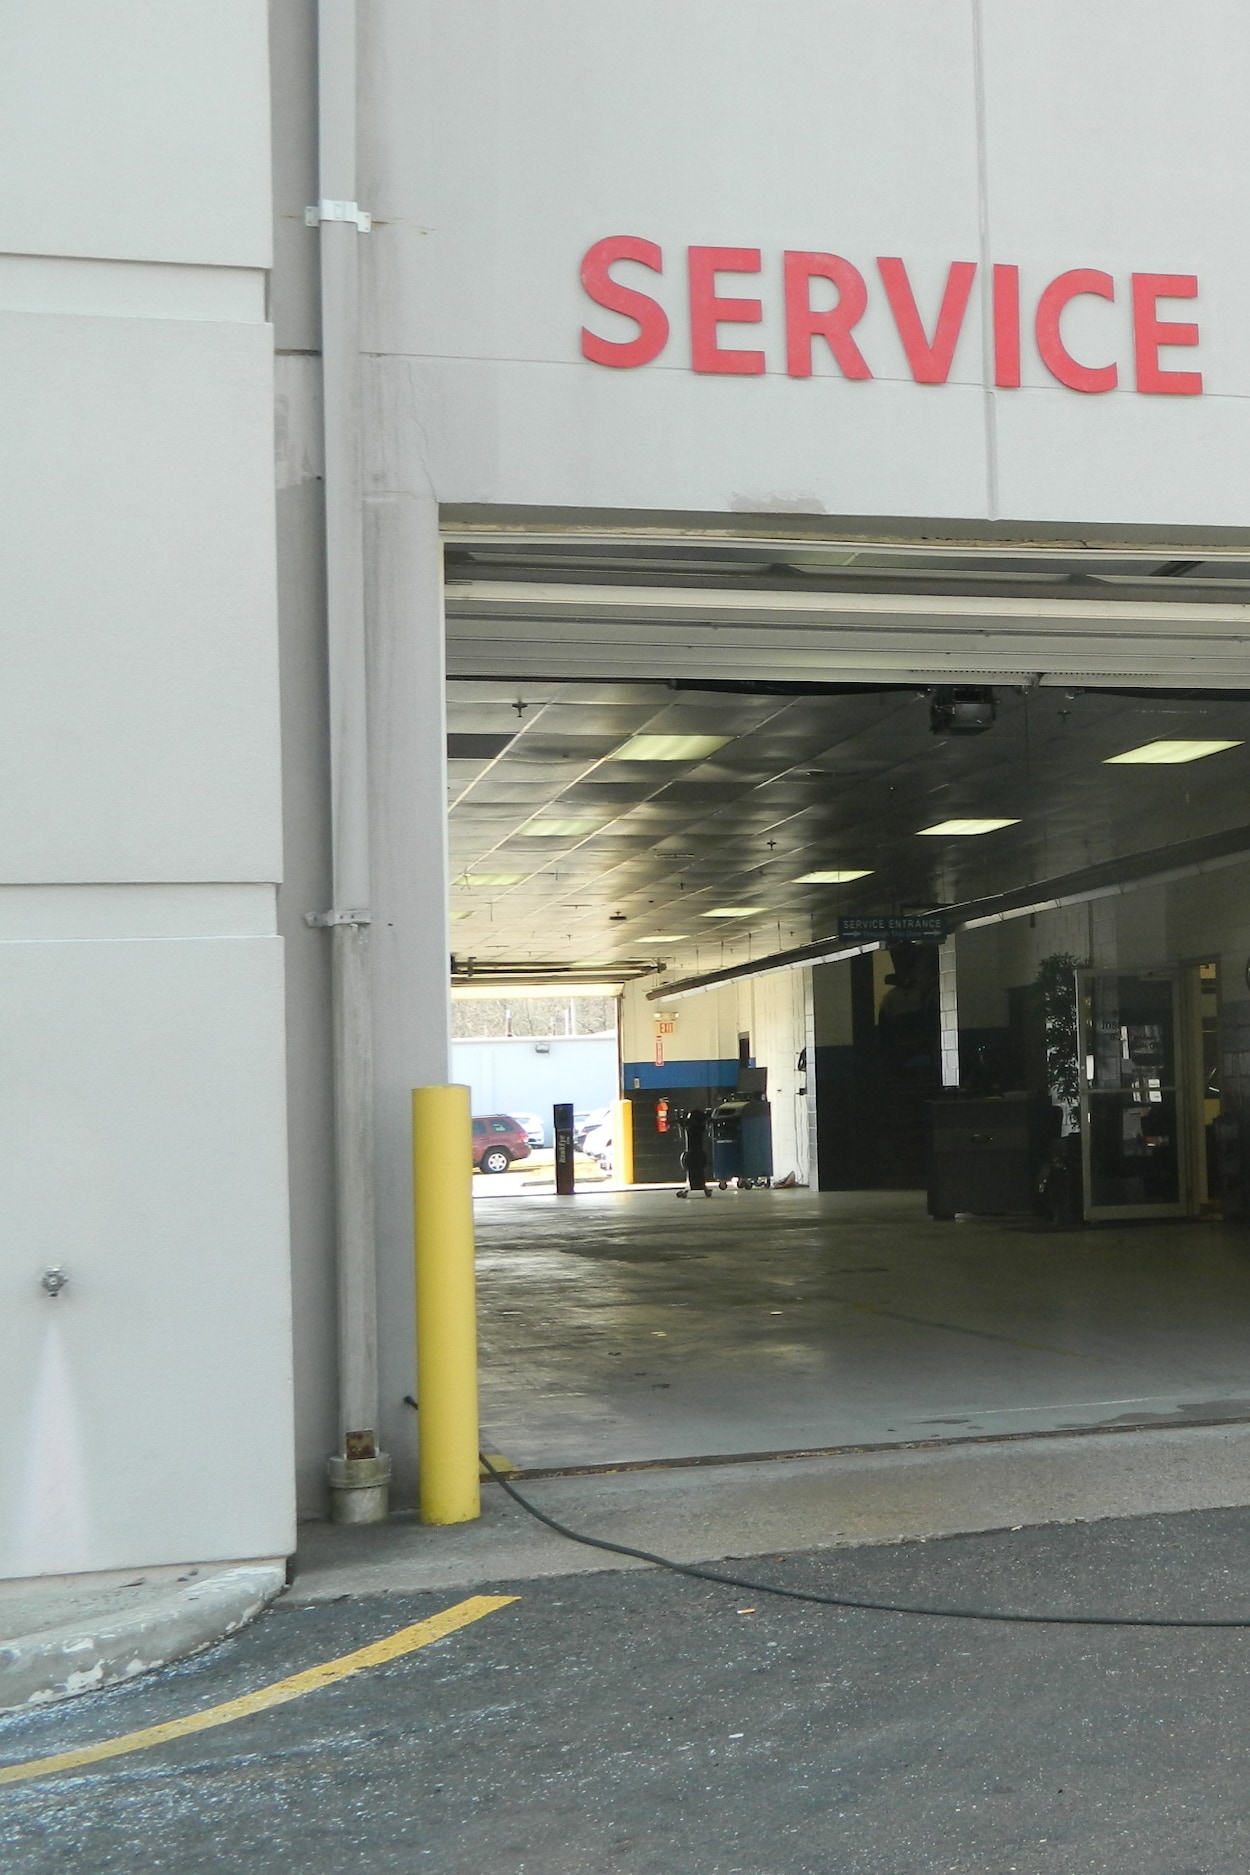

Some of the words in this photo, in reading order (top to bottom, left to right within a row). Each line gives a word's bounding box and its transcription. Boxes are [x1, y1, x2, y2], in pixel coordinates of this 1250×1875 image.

[579, 235, 1203, 394] SERVICE
[843, 919, 885, 929] SERVICE
[888, 919, 942, 929] ENTRANCE
[660, 1022, 674, 1034] EXIT
